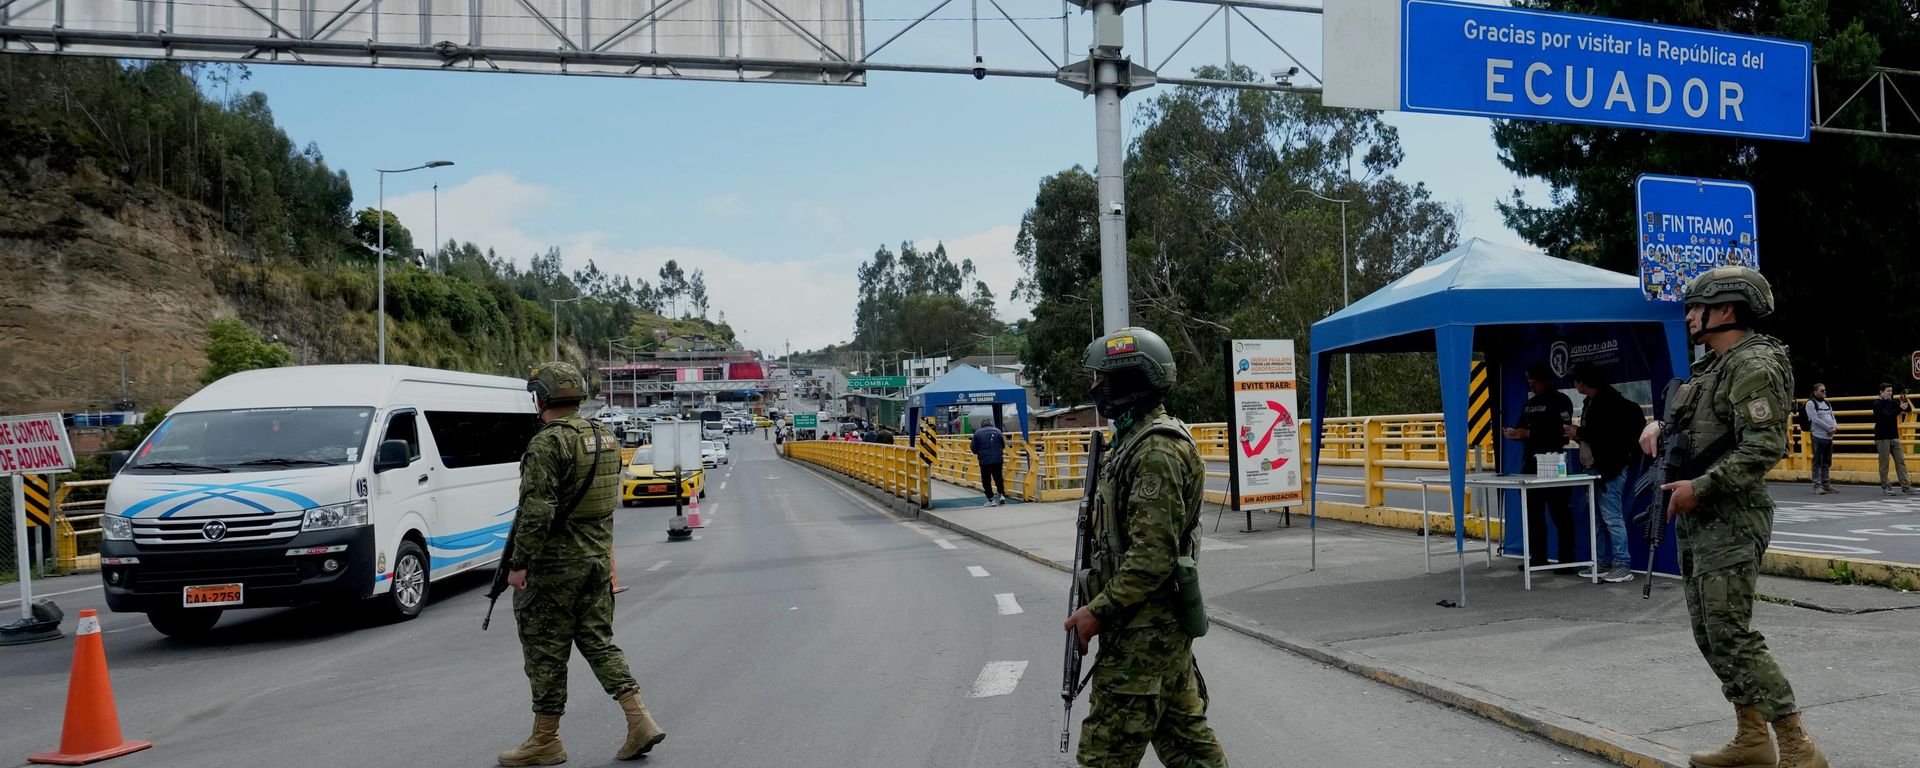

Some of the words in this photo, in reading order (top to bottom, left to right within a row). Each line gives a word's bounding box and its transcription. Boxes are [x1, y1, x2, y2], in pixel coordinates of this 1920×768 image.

[1464, 19, 1536, 45] Gracias
[1542, 31, 1571, 50] por
[1577, 32, 1632, 55] visitar
[1638, 38, 1651, 57] la
[1657, 40, 1737, 65] República
[1742, 50, 1764, 70] del
[1487, 58, 1744, 122] ECUADOR
[1662, 214, 1684, 233] FIN
[1686, 215, 1734, 236] TRAMO
[1241, 382, 1263, 390] EVITE
[1265, 381, 1291, 389] TRAER:
[13, 420, 59, 444] CONTROL
[16, 445, 64, 470] ADUANA
[357, 478, 368, 497] 05
[1255, 492, 1299, 502] AUTORIZACIÓN
[186, 591, 241, 604] CAA-2759
